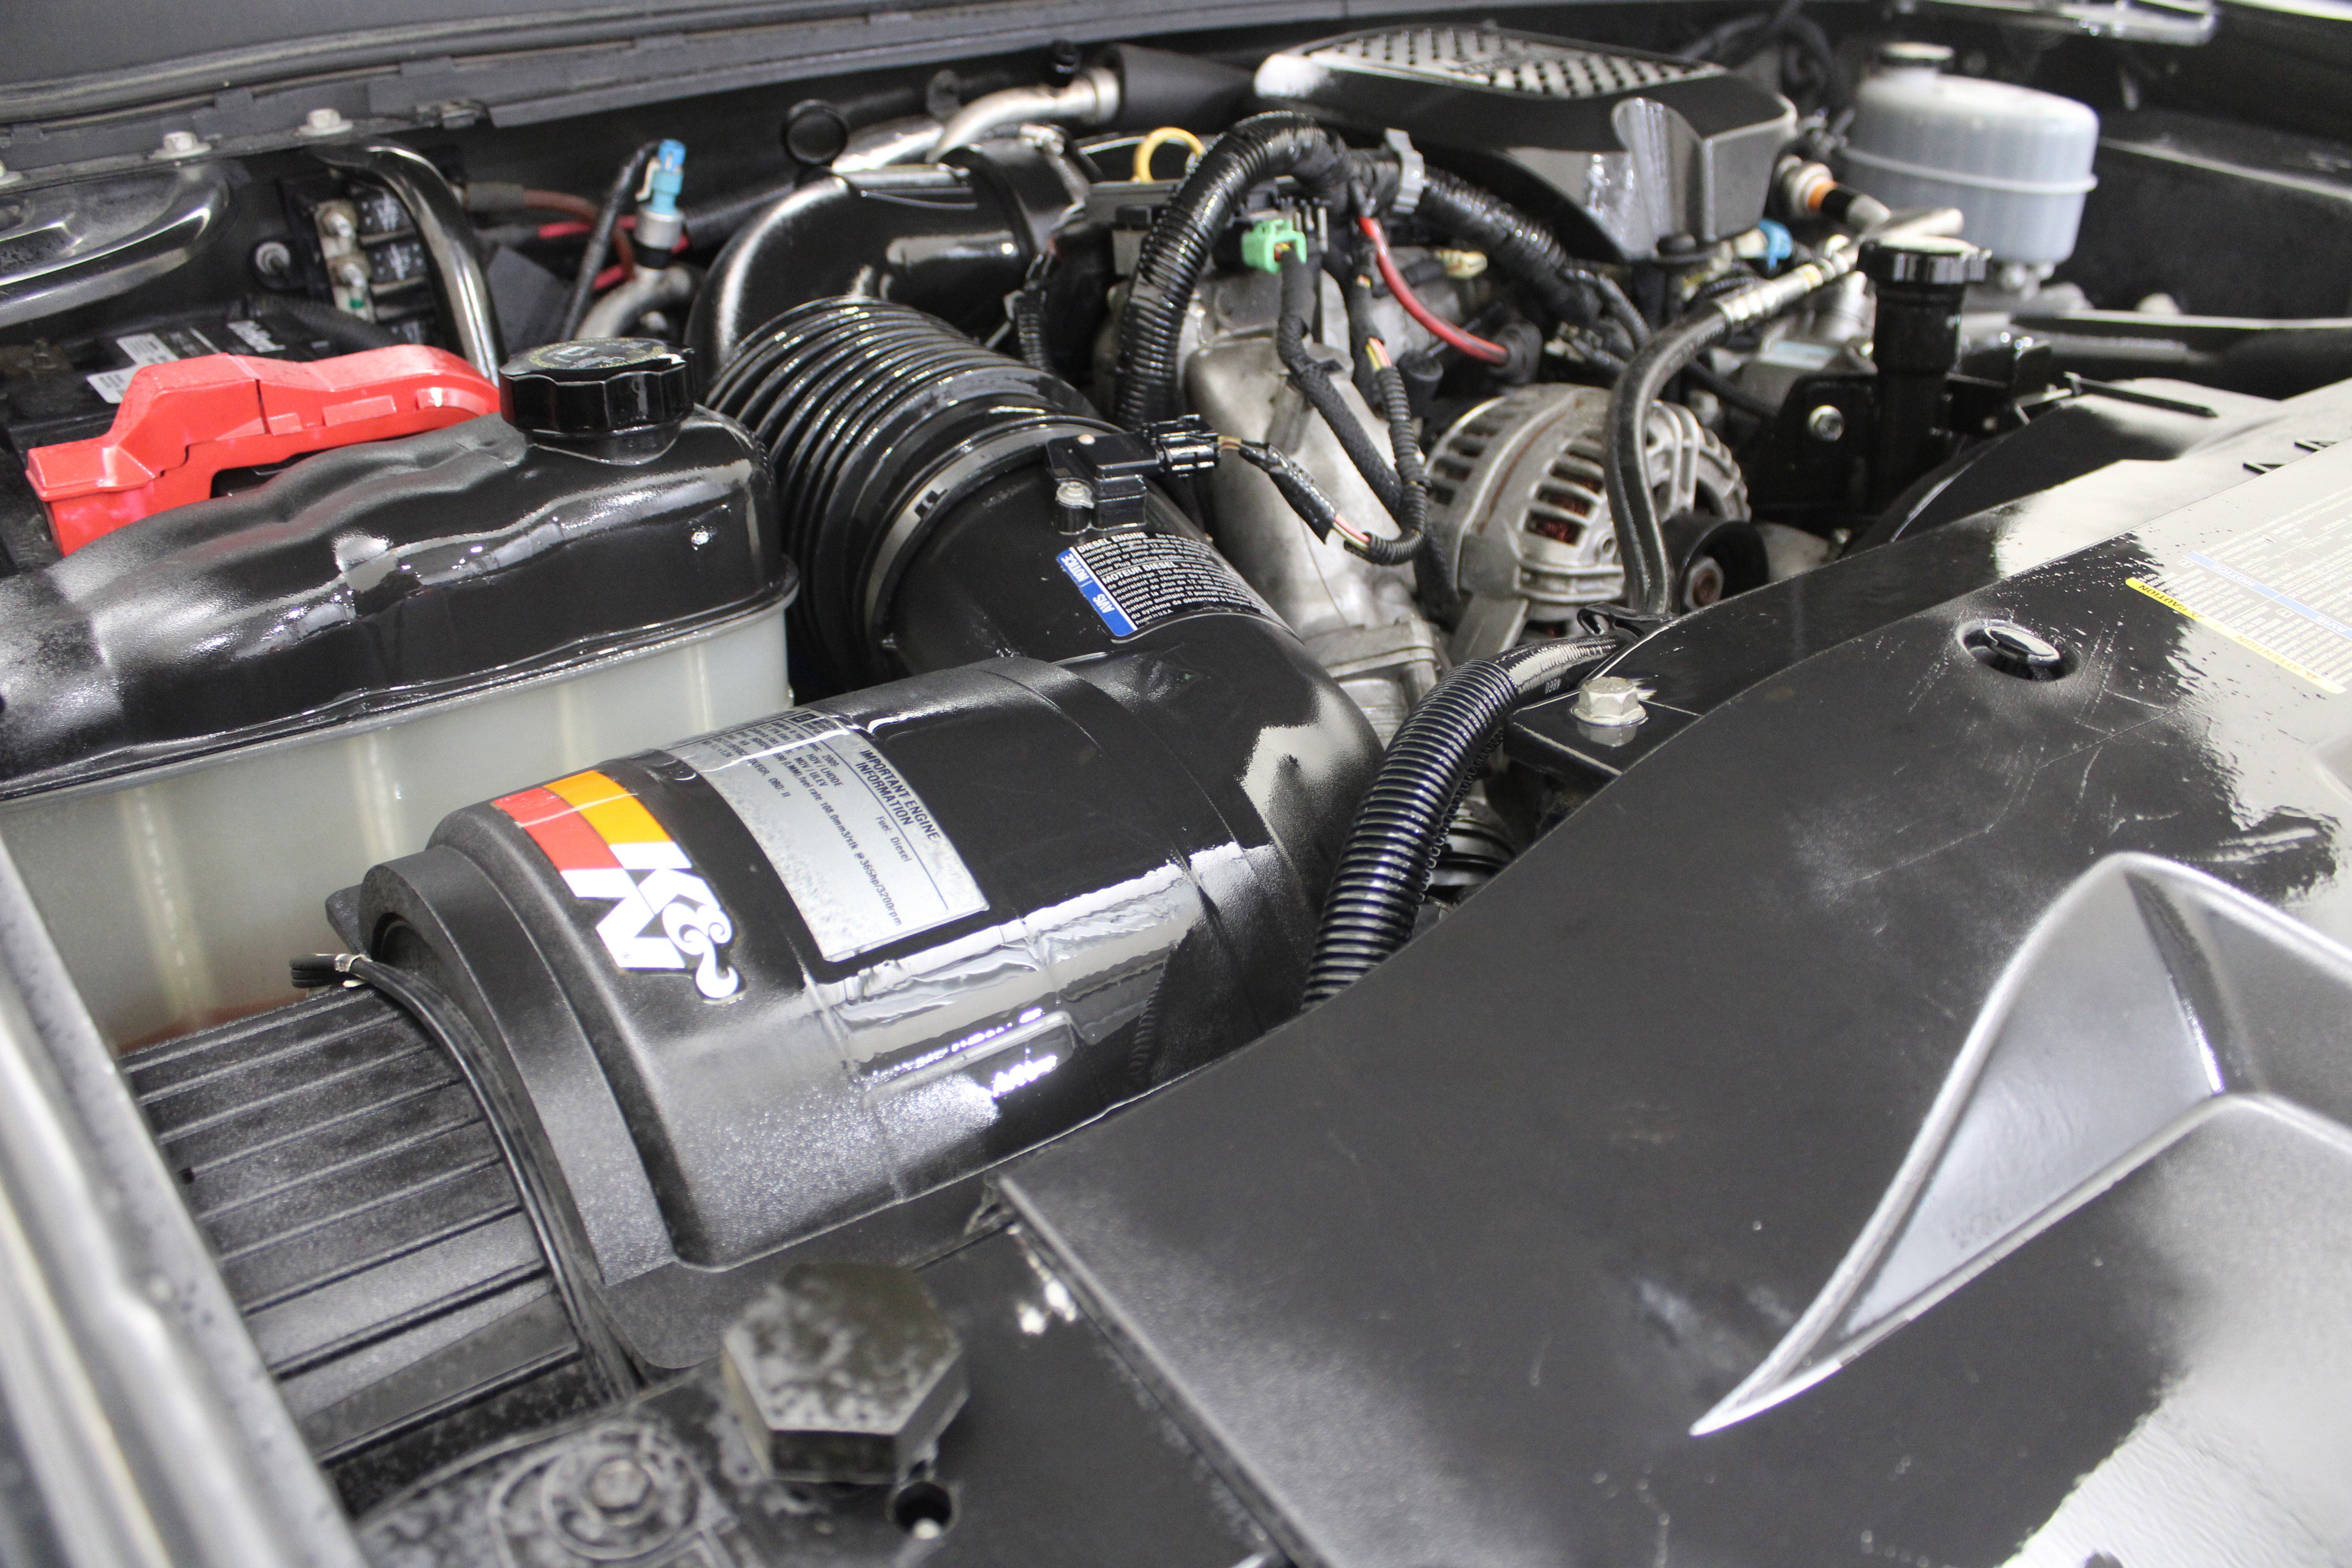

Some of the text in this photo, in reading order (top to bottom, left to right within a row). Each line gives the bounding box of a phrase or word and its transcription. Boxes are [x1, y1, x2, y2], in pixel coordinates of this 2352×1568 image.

[1076, 538, 1112, 553] DIESEL
[1111, 532, 1148, 543] ENGINE
[1087, 554, 1105, 564] more
[1121, 544, 1149, 552] nominal
[1091, 556, 1122, 570] charging
[1061, 553, 1089, 583] NOTICE
[1096, 566, 1114, 576] Glow
[1114, 561, 1131, 569] Plug
[1131, 555, 1159, 564] Starting
[1101, 566, 1143, 584] MOTEUR
[1142, 561, 1179, 572] DIESEL
[2209, 563, 2256, 588] NOTICE
[1111, 580, 1149, 597] pourraient
[1116, 586, 1149, 602] nominale
[1121, 593, 1151, 608] pendant
[1160, 586, 1184, 595] charge
[2138, 584, 2187, 611] CAUTION
[1093, 593, 1115, 614] AVIS
[1125, 600, 1154, 613] batterie
[1135, 615, 1153, 625] Printed
[2314, 616, 2348, 633] AVIS
[2236, 635, 2305, 670] ATTENTION
[767, 777, 786, 793] OBD:
[808, 772, 828, 787] ULEV
[820, 767, 843, 787] LHDDE
[807, 788, 824, 801] rate
[855, 762, 914, 826] INFORMATION
[859, 749, 940, 840] IMPORTANT ENGINE
[874, 816, 911, 862] Fuel: Diesel
[559, 840, 740, 1000] K&N
